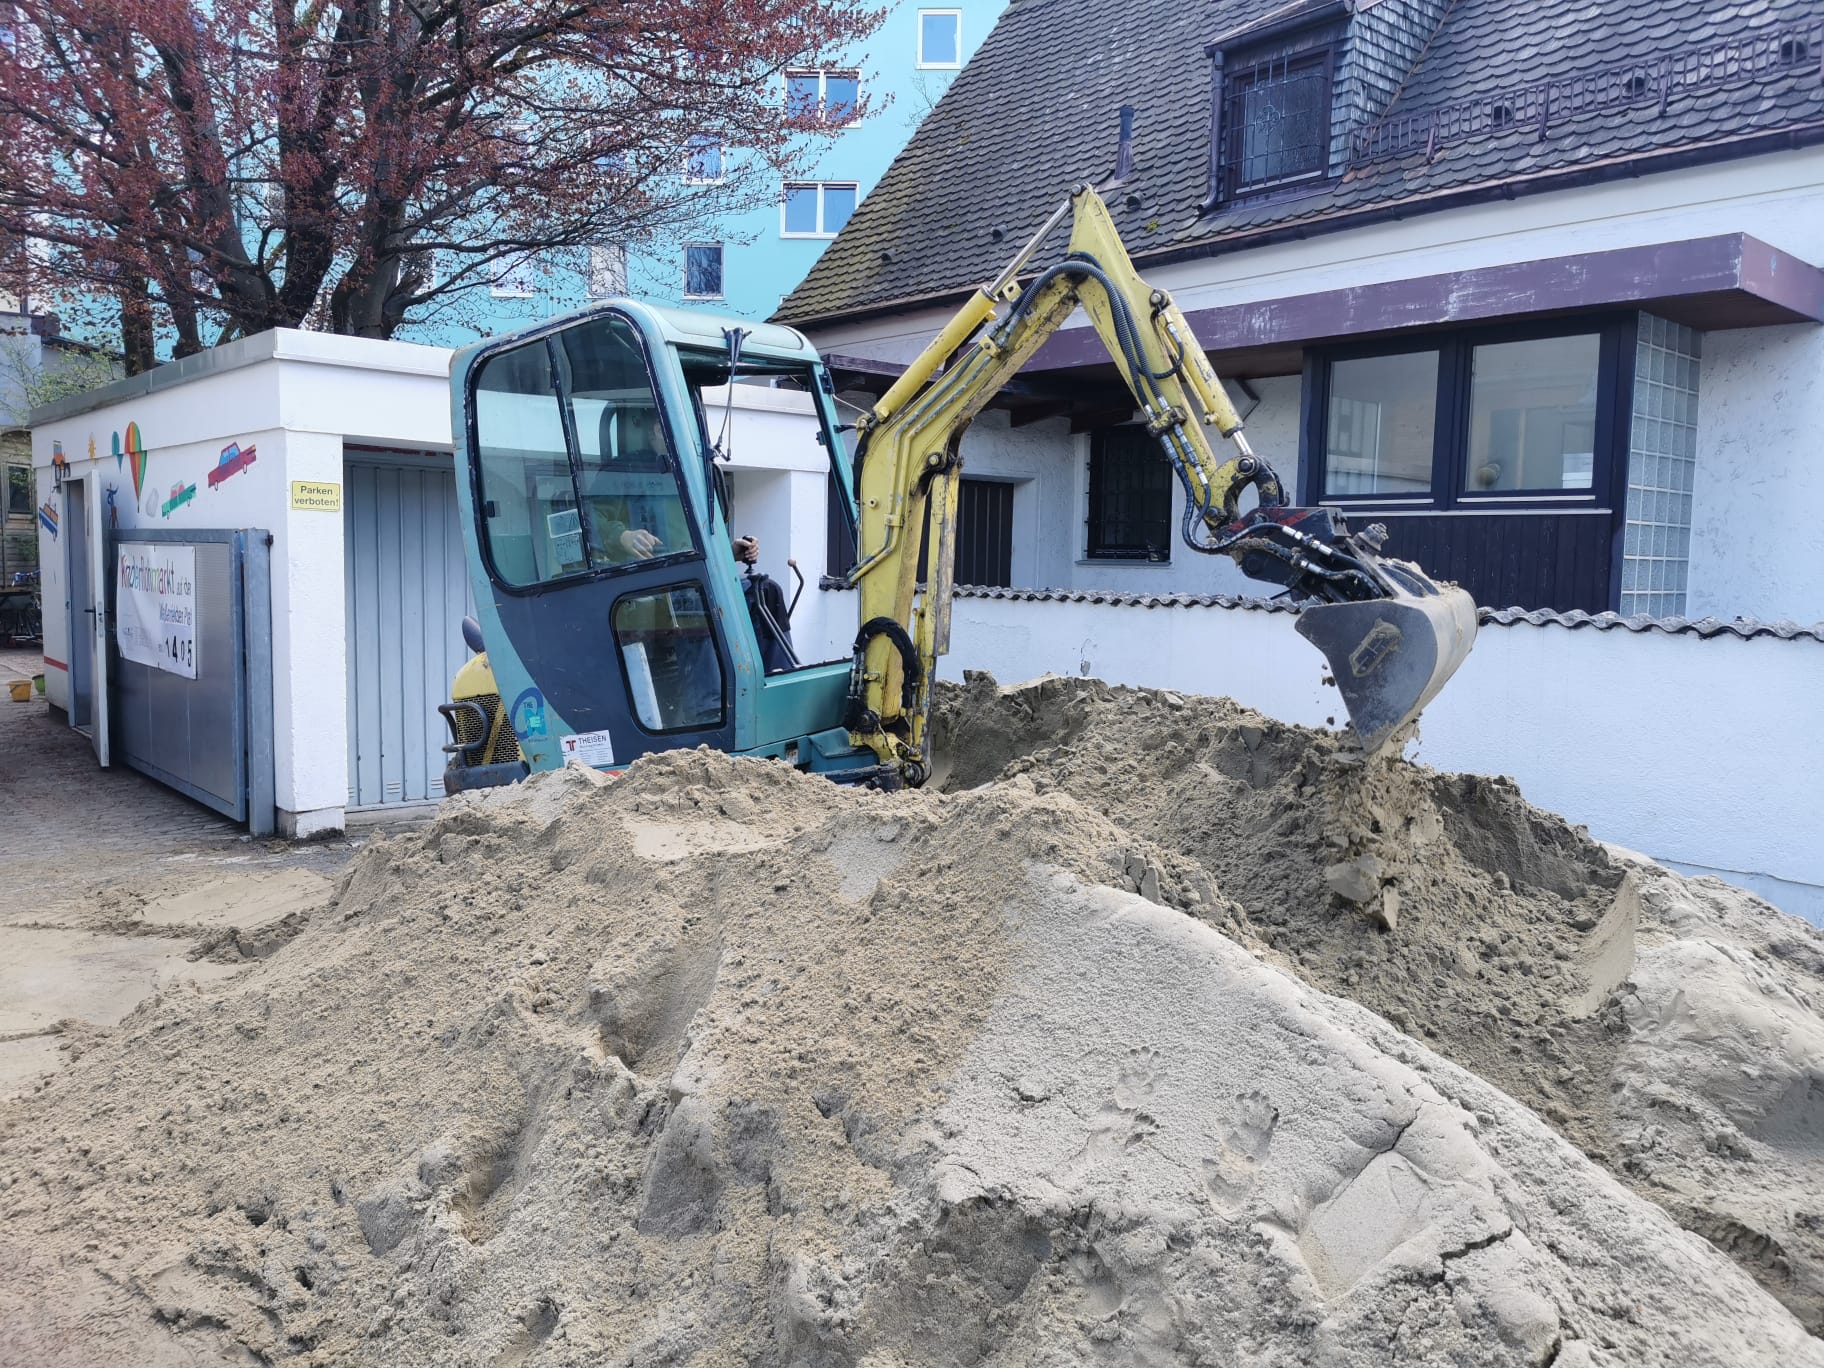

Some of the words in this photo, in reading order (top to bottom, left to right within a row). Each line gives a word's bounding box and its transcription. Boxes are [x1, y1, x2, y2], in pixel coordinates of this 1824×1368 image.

[300, 486, 333, 495] Parken
[294, 497, 339, 507] verboten!
[578, 736, 607, 744] THEISEN
